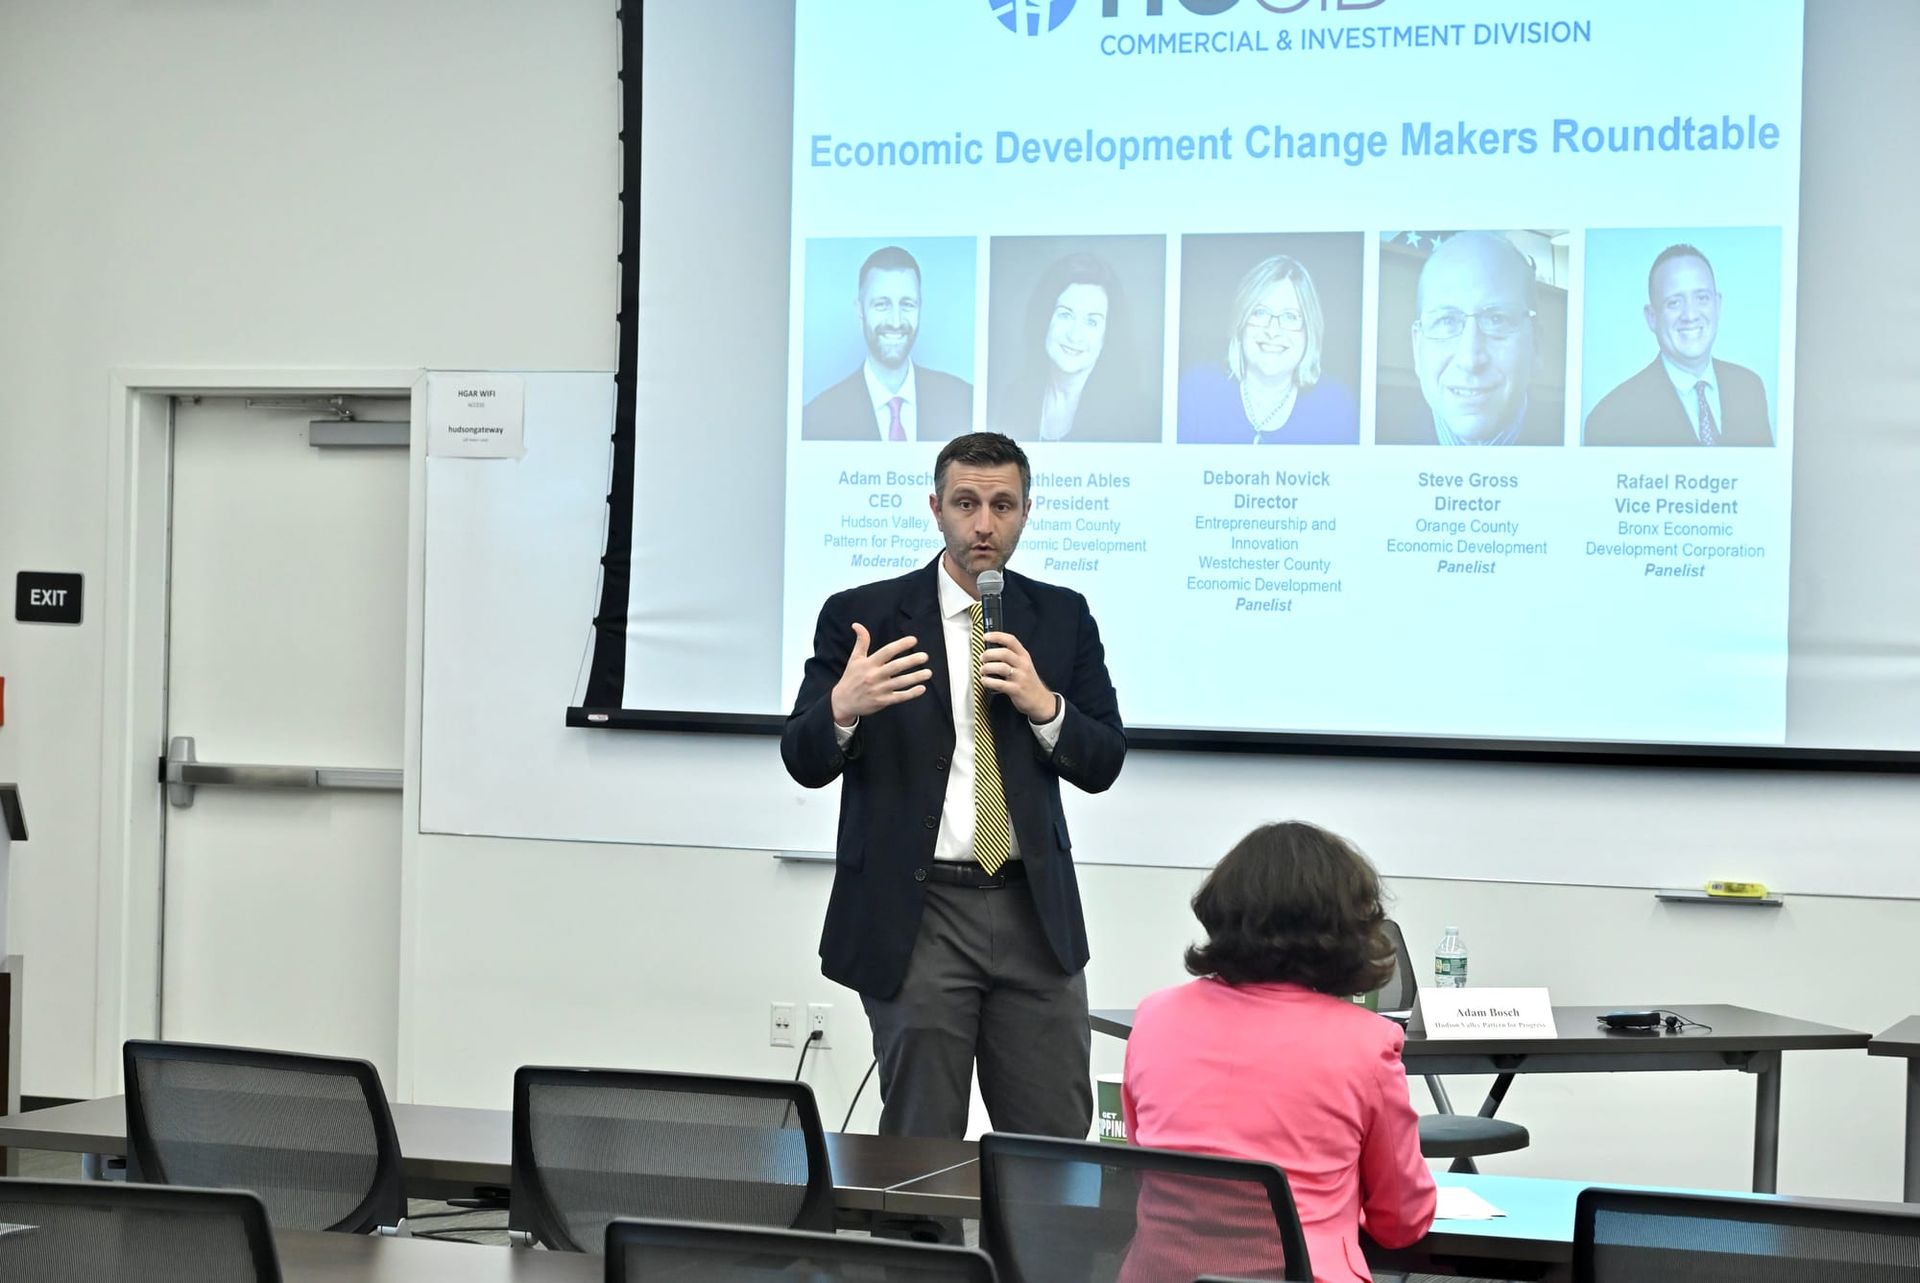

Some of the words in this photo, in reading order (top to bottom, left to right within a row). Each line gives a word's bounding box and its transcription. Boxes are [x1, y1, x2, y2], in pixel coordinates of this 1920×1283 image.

[1100, 30, 1269, 56] COMMERCIAL
[1276, 30, 1293, 51] &
[1301, 24, 1466, 50] INVESTMENT
[1473, 20, 1592, 45] DIVISION
[810, 133, 983, 167] Economic
[995, 128, 1233, 169] Development
[1244, 125, 1388, 166] Change
[1401, 121, 1539, 156] Makers
[1552, 114, 1781, 153] Roundtable
[458, 390, 478, 398] HGAR
[838, 471, 881, 485] Adam
[886, 471, 934, 486] Bosch
[1086, 473, 1131, 488] Ables
[1203, 470, 1270, 486] Deborah
[1276, 471, 1331, 487] Novick
[1418, 472, 1464, 488] Steve
[1468, 472, 1519, 488] Gross
[1616, 473, 1669, 490] Rafael
[1674, 474, 1738, 494] Rodger
[868, 493, 903, 508] CEO
[1035, 495, 1110, 511] President
[1234, 494, 1299, 509] Director
[1434, 496, 1501, 512] Director
[1615, 498, 1651, 514] Vice
[1656, 498, 1739, 514] President
[841, 514, 888, 528] Hudson
[891, 515, 930, 533] Valley
[1075, 518, 1121, 535] County
[1195, 515, 1308, 532] Entrepreneurship
[1311, 518, 1337, 531] and
[1415, 518, 1466, 535] Orange
[1470, 519, 1519, 536] County
[1618, 520, 1659, 535] Bronx
[1664, 521, 1733, 537] Economic
[823, 534, 868, 548] Pattern
[871, 534, 888, 548] for
[1063, 537, 1147, 554] Development
[1231, 536, 1299, 551] Innovation
[1387, 538, 1453, 553] Economic
[1457, 539, 1548, 557] Development
[1586, 541, 1678, 559] Development
[1682, 542, 1766, 560] Corporation
[850, 554, 920, 568] Moderator
[1044, 557, 1099, 571] Panelist
[1199, 555, 1280, 570] Westchester
[1284, 557, 1331, 574] County
[1437, 559, 1496, 574] Panelist
[1644, 563, 1706, 577] Panelist
[1187, 576, 1251, 591] Economic
[1255, 577, 1342, 595] Development
[30, 588, 68, 607] EXIT
[1235, 597, 1293, 612] Panelist
[1457, 1008, 1487, 1017] Adam
[1489, 1008, 1520, 1017] Bosch
[1102, 1111, 1117, 1119] GET
